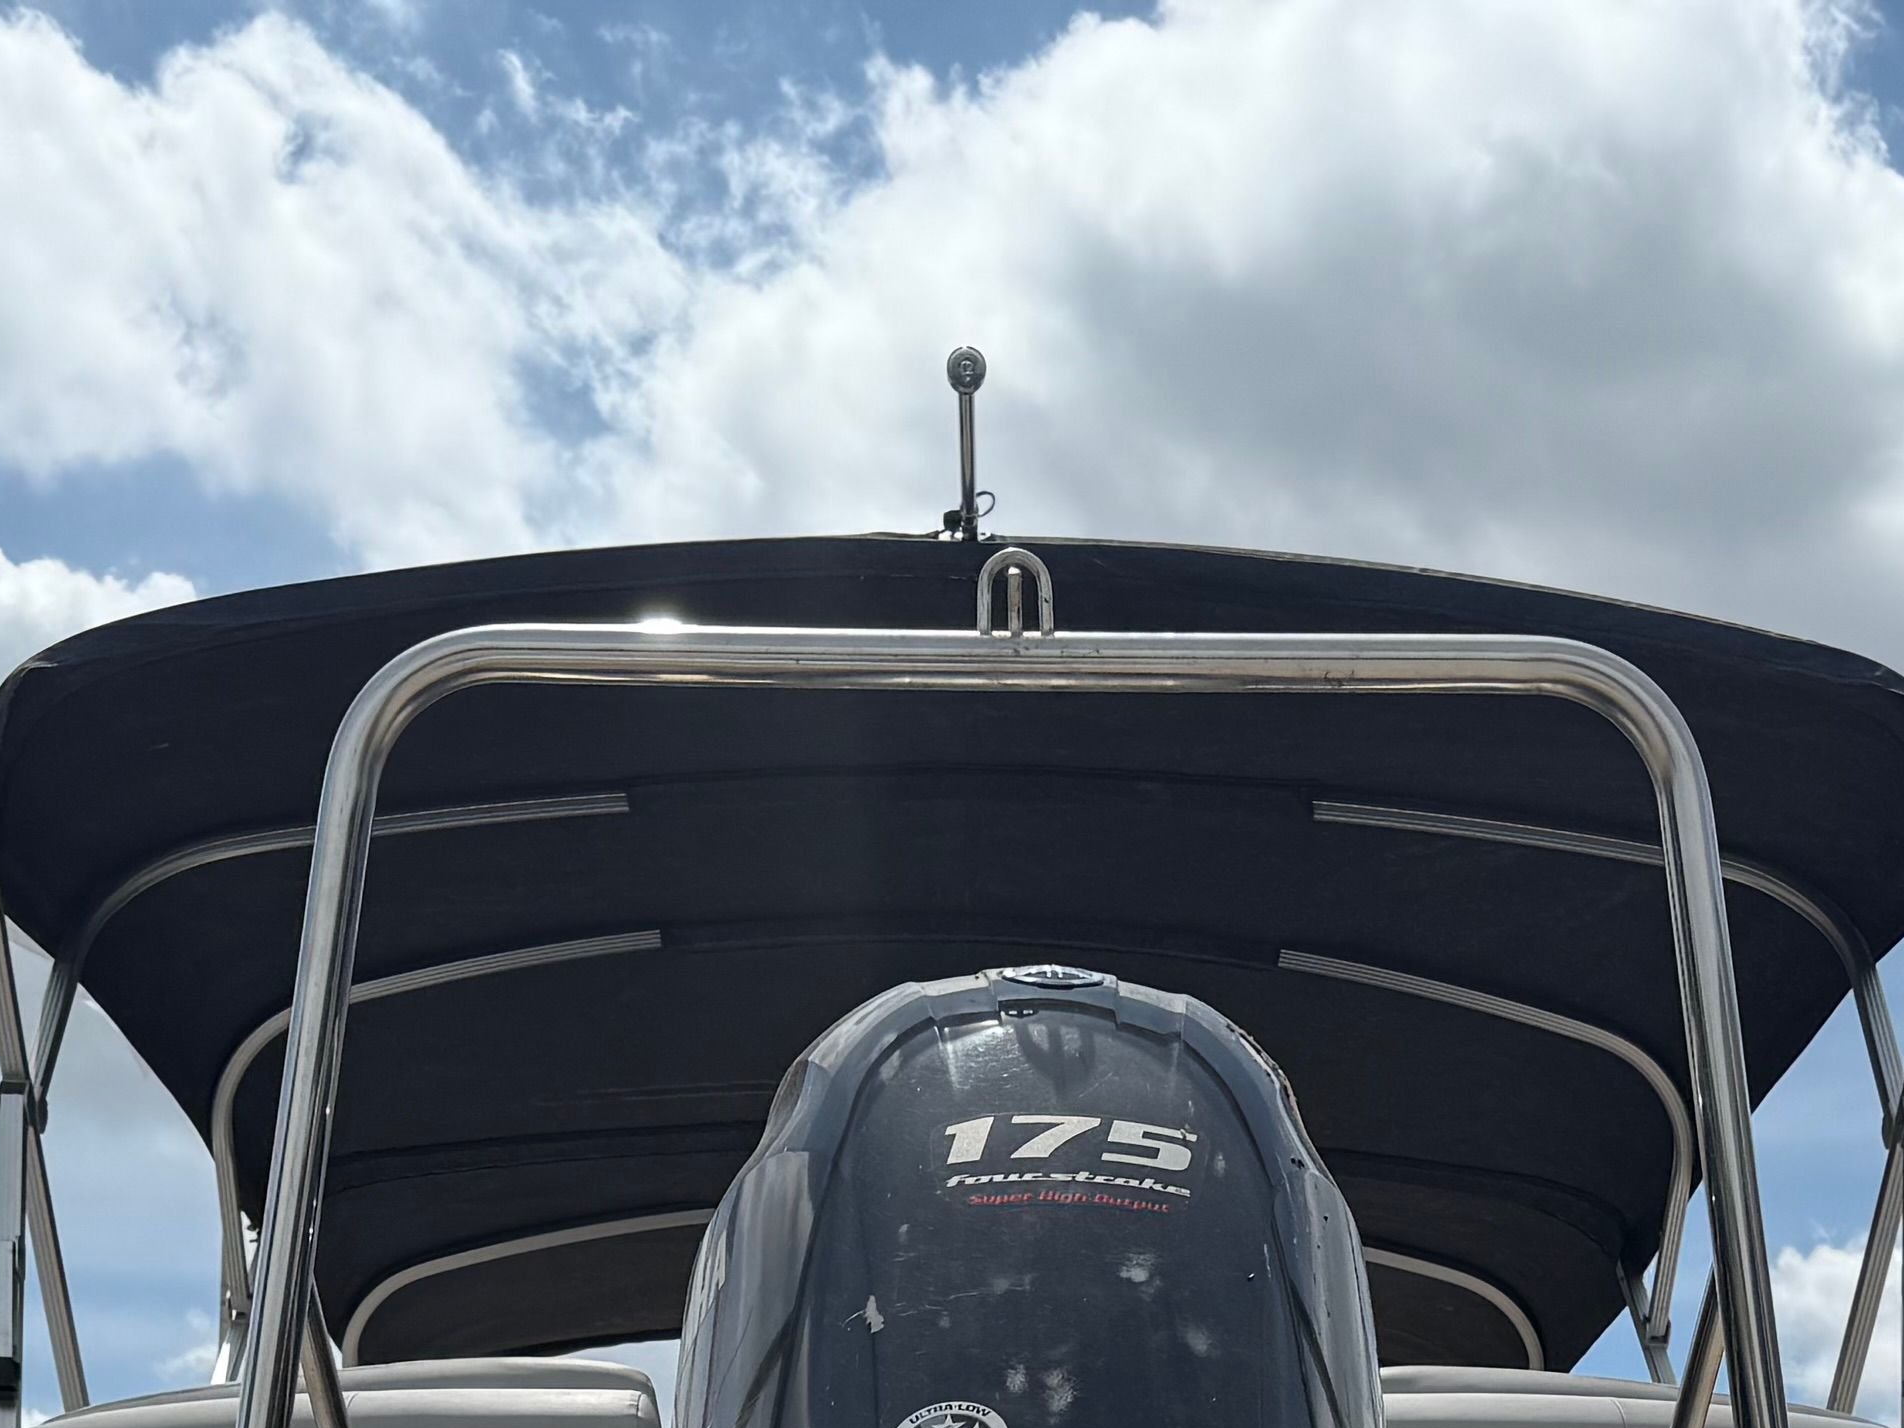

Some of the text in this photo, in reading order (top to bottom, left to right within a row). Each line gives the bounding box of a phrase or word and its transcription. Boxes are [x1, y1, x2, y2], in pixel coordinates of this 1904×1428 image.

[944, 1115, 1197, 1171] 175
[969, 1192, 1033, 1206] Super
[1039, 1190, 1090, 1205] High
